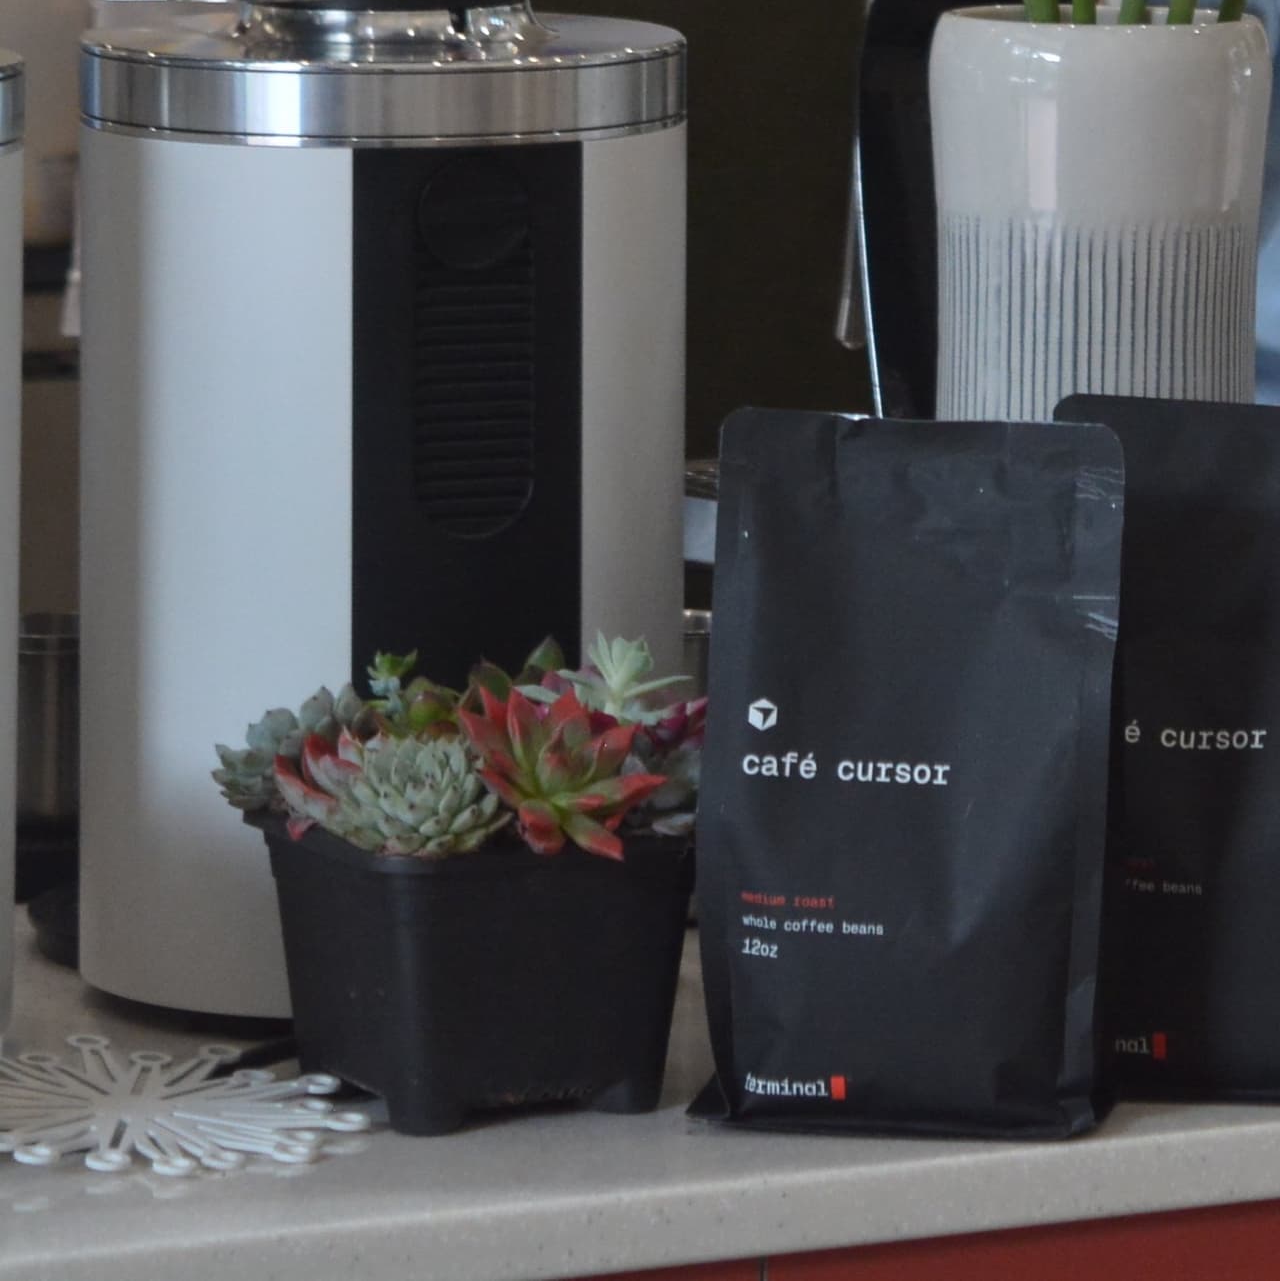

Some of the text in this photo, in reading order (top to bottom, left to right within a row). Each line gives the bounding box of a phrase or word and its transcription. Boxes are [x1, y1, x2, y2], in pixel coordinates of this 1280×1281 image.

[1160, 728, 1268, 750] cursor
[742, 752, 951, 785] café cursor
[741, 891, 835, 909] medium roast
[742, 914, 884, 936] whole coffee beans
[742, 938, 778, 958] 12oz
[744, 1073, 828, 1096] terminal
